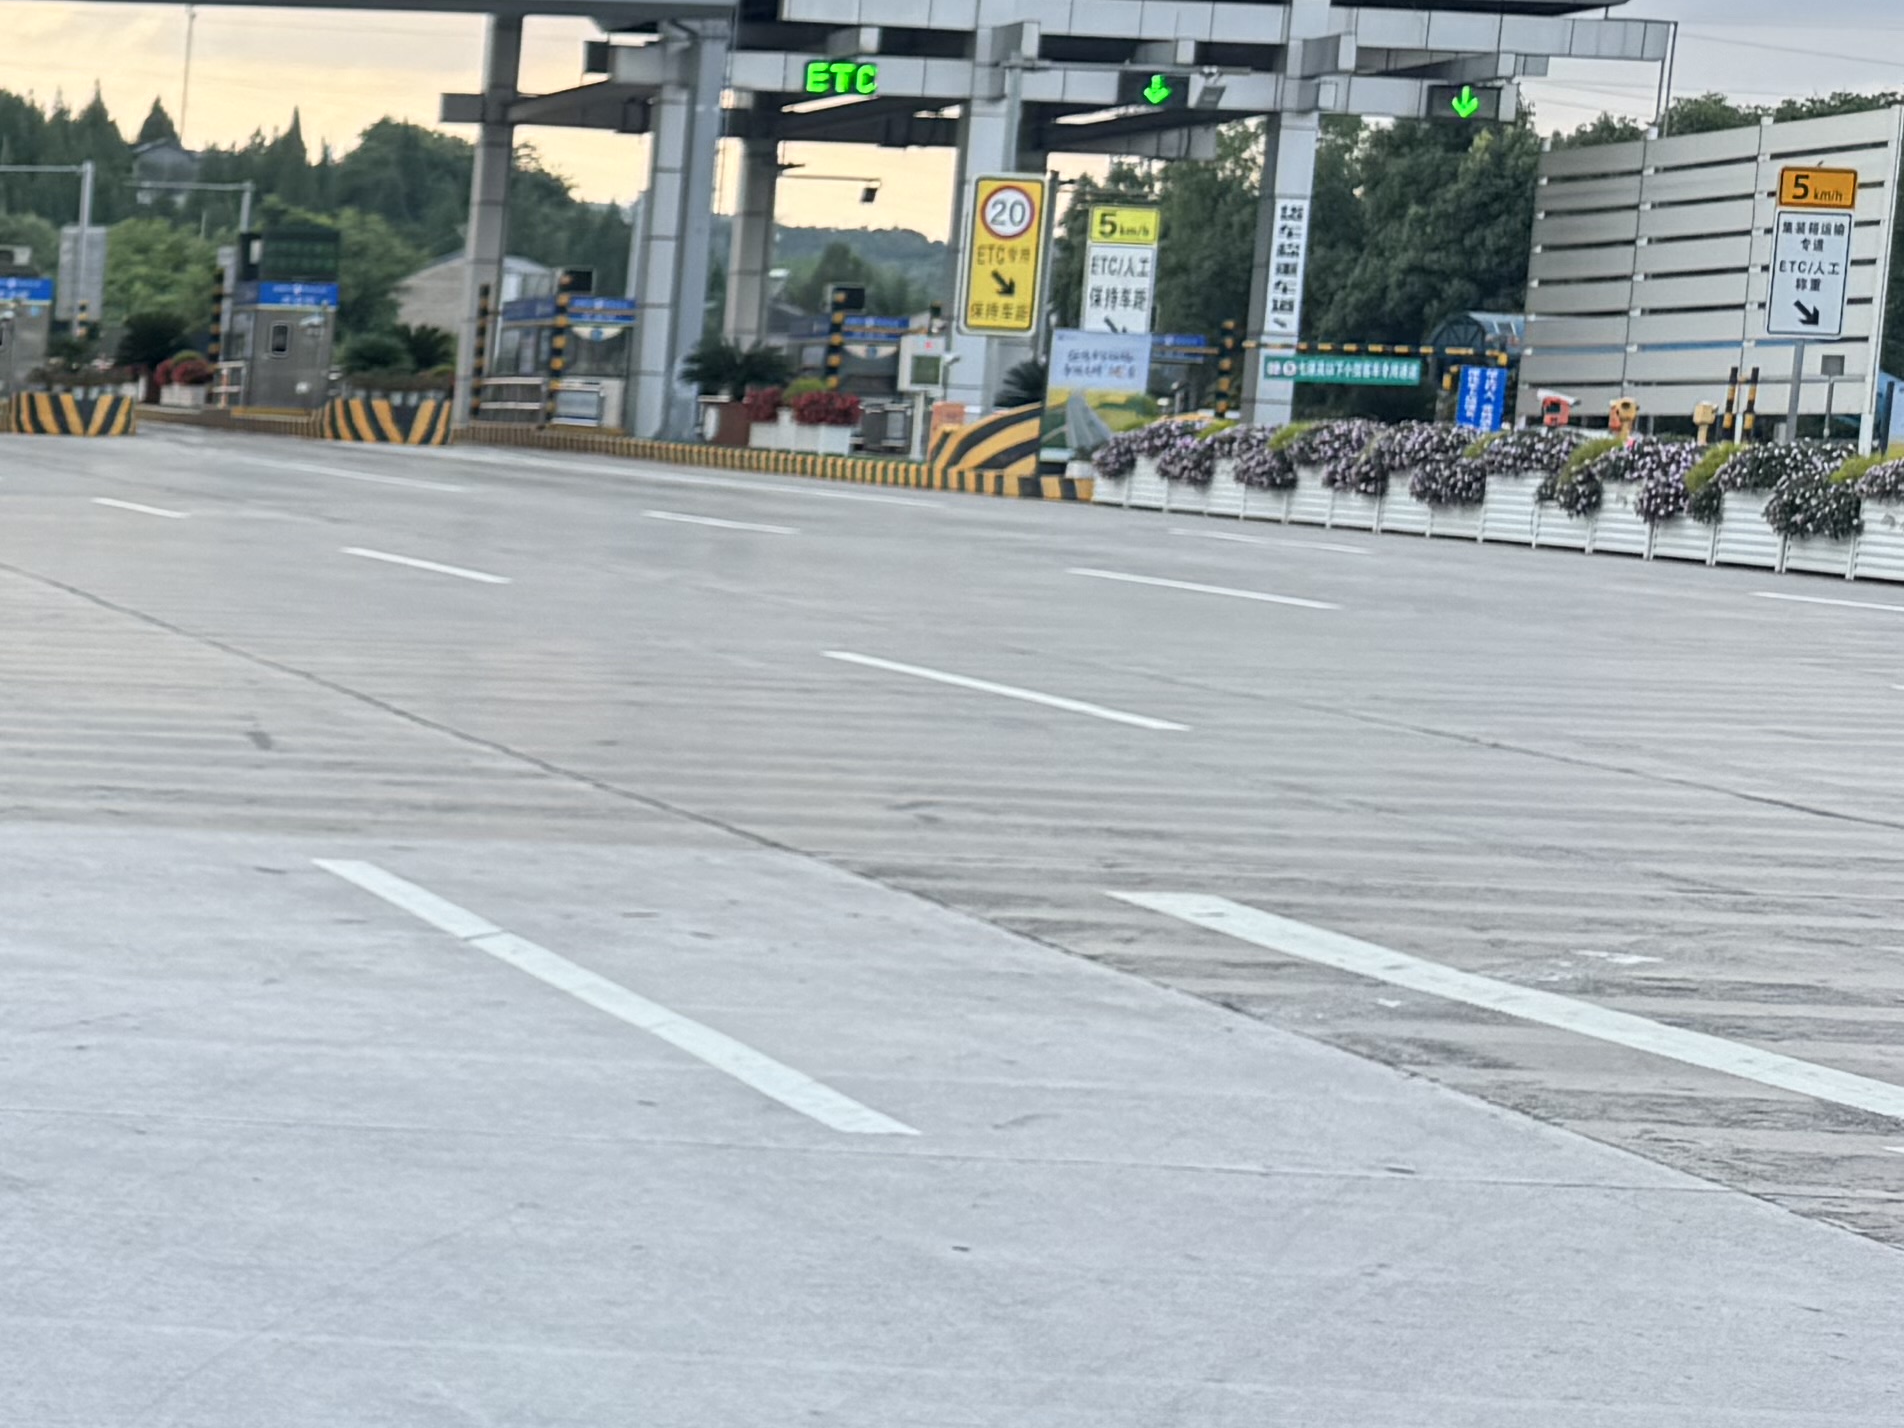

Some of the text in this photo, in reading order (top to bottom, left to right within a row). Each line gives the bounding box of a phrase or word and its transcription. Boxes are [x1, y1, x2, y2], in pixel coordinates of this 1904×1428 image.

[806, 62, 879, 94] ETC
[1792, 174, 1844, 202] 5 km/h
[990, 199, 1026, 227] 20
[1099, 212, 1117, 238] 5
[1091, 254, 1150, 278] ETC/人工
[1778, 260, 1840, 276] ETC/人工
